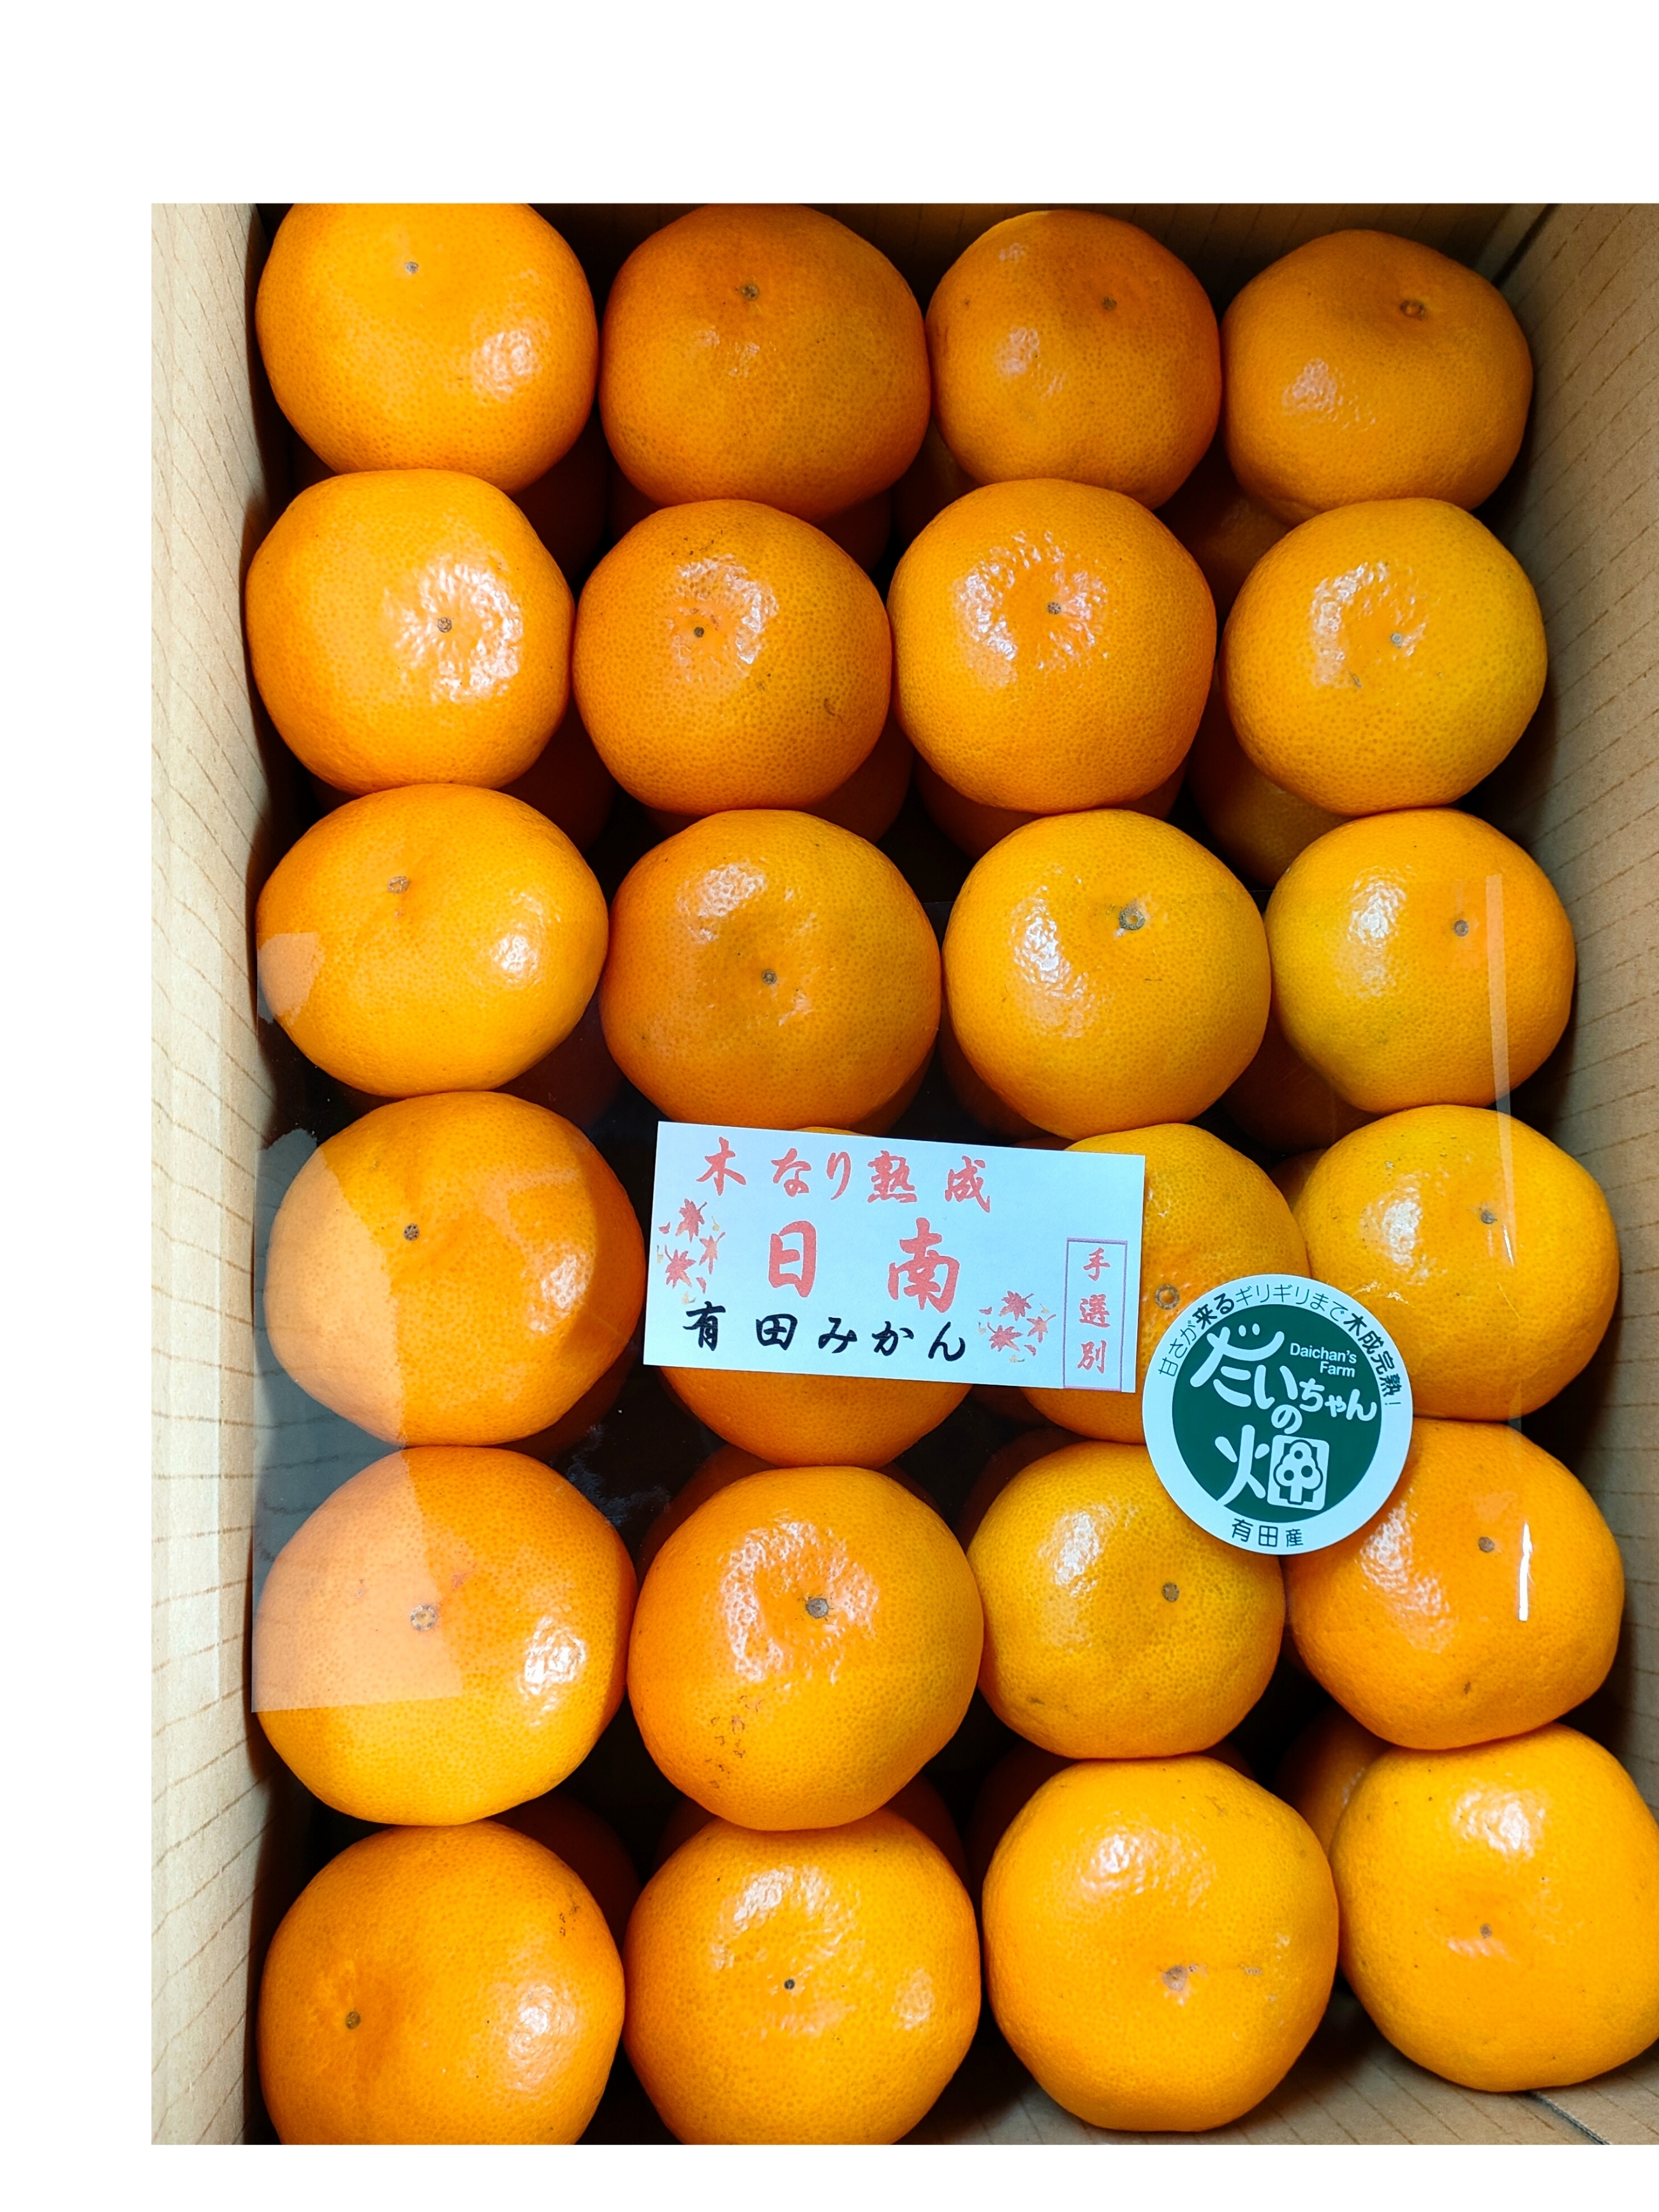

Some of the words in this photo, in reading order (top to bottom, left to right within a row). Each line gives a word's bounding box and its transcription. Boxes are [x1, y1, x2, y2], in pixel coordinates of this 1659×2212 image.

[696, 1137, 991, 1213] 木なり熟成
[769, 1218, 961, 1313] 日南
[683, 1302, 966, 1361] 有田みかん
[1076, 1247, 1110, 1375] 手選別
[1290, 1343, 1357, 1364] Daichan's
[1320, 1361, 1355, 1378] Farm
[1271, 1404, 1302, 1434] の
[1232, 1518, 1304, 1547] 有田産
